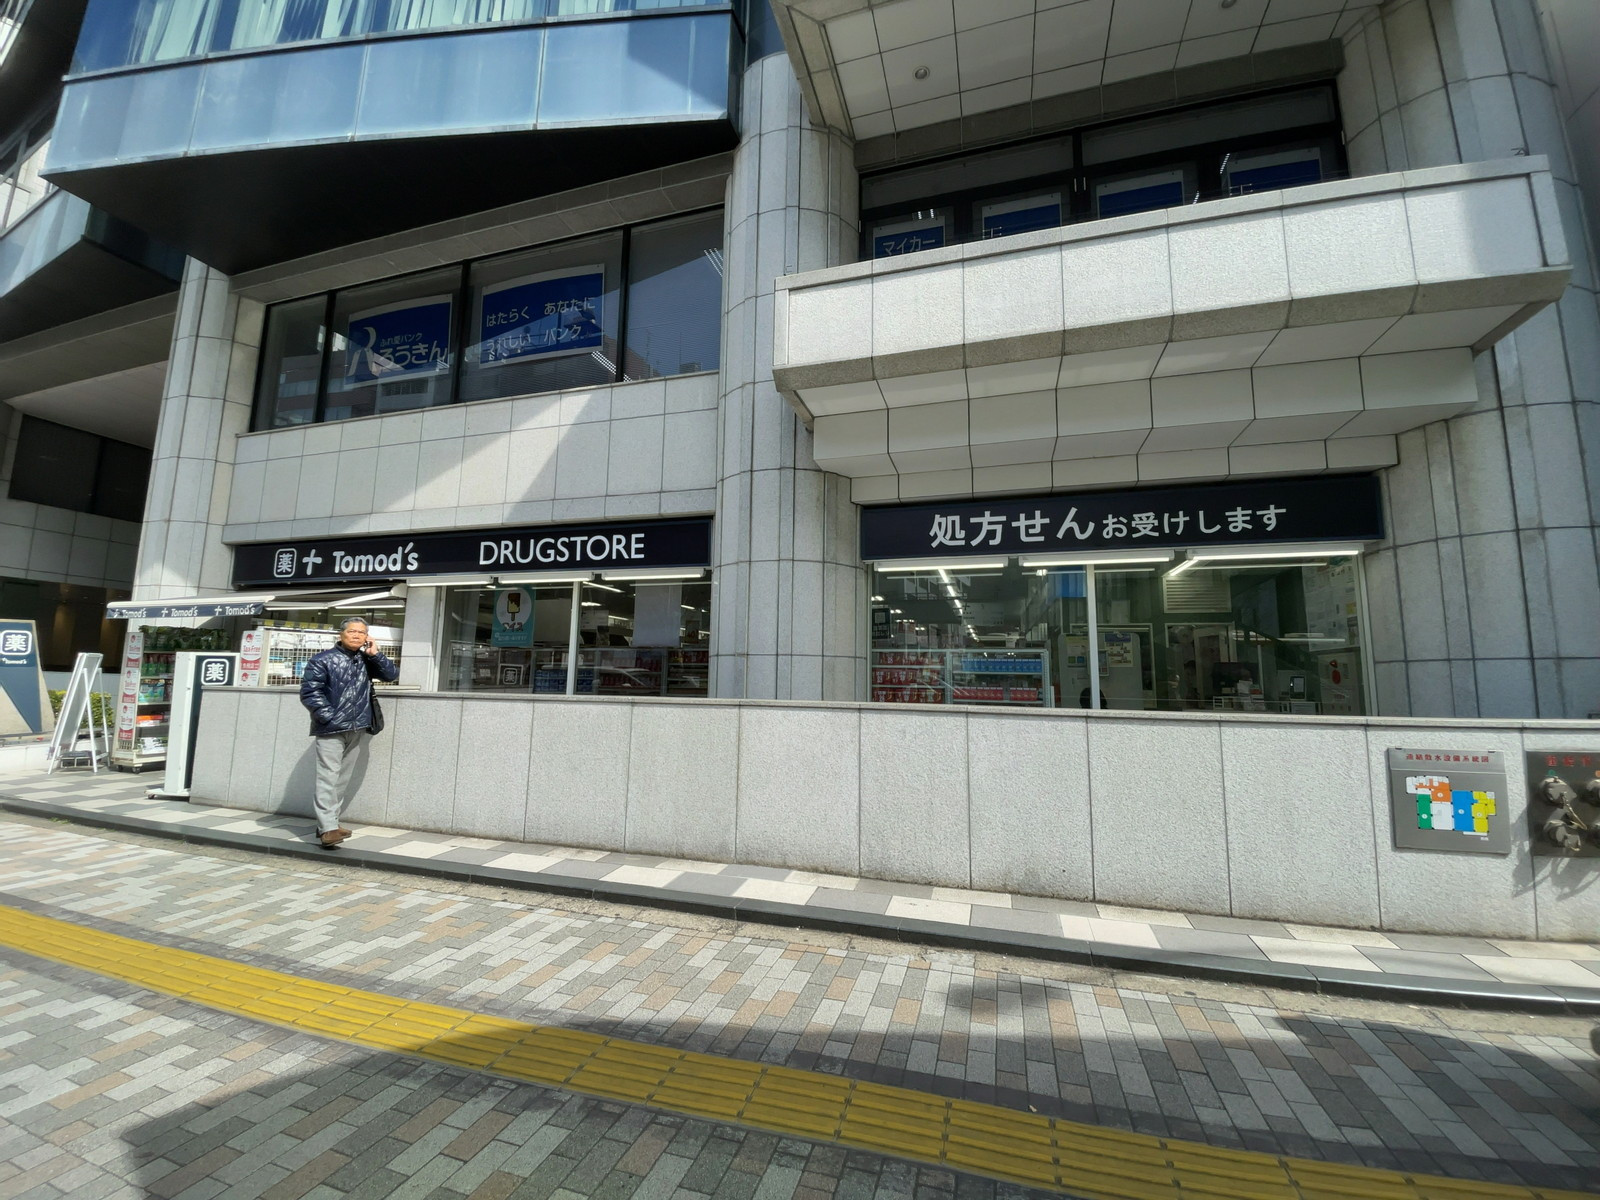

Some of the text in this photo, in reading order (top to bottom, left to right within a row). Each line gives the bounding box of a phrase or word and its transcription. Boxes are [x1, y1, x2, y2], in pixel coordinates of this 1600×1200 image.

[882, 235, 935, 256] マイカー
[486, 297, 596, 327] はたらく あなたに
[379, 340, 448, 367] ろうきん
[332, 542, 419, 574] Tomod's
[479, 533, 645, 565] DRUGSTORE
[276, 551, 294, 574] 薬
[3, 633, 28, 652] 薬
[204, 661, 226, 682] 薬
